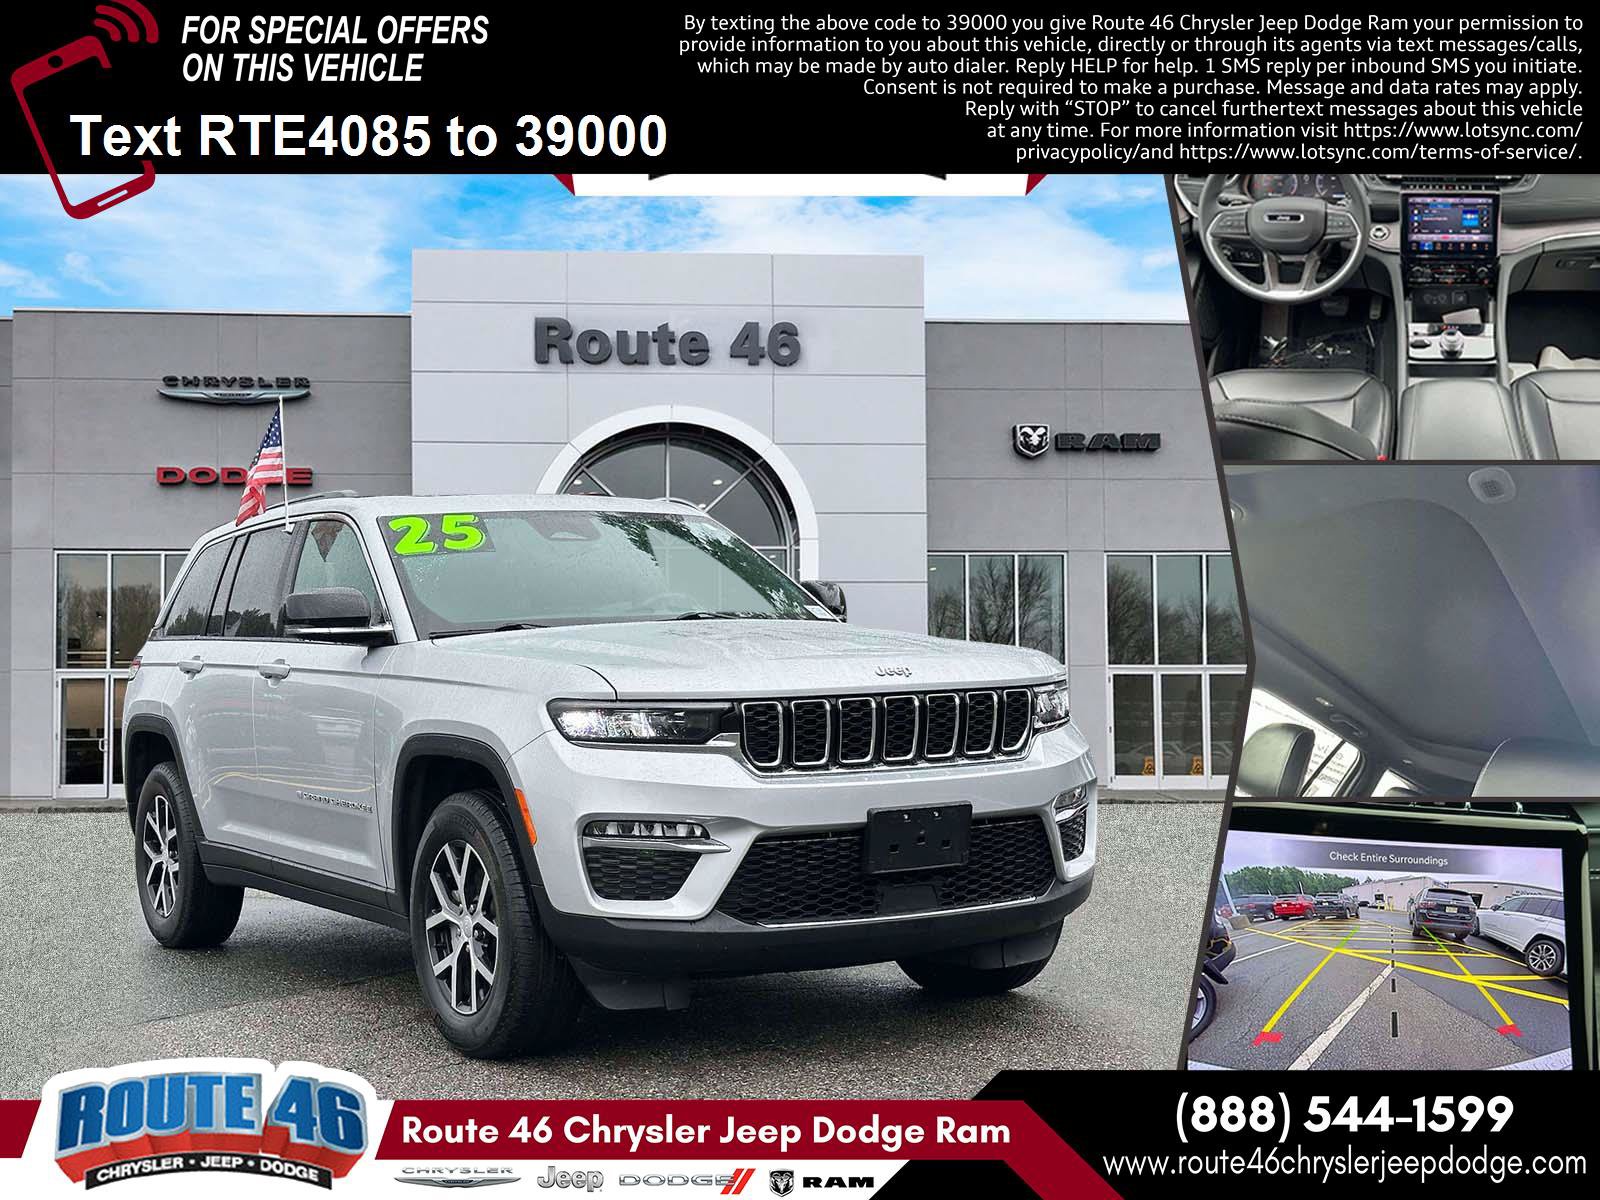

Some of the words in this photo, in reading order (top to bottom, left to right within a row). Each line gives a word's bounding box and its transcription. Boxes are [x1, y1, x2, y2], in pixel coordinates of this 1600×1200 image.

[534, 317, 710, 365] Route
[730, 321, 801, 366] 46
[162, 375, 311, 388] CHRYSLER
[1055, 433, 1161, 452] RAM
[157, 467, 313, 485] DODE
[388, 513, 486, 556] 25
[875, 665, 913, 678] Jeep
[1329, 851, 1359, 862] Check
[1360, 853, 1388, 864] Entire
[1389, 854, 1449, 868] Surroundings
